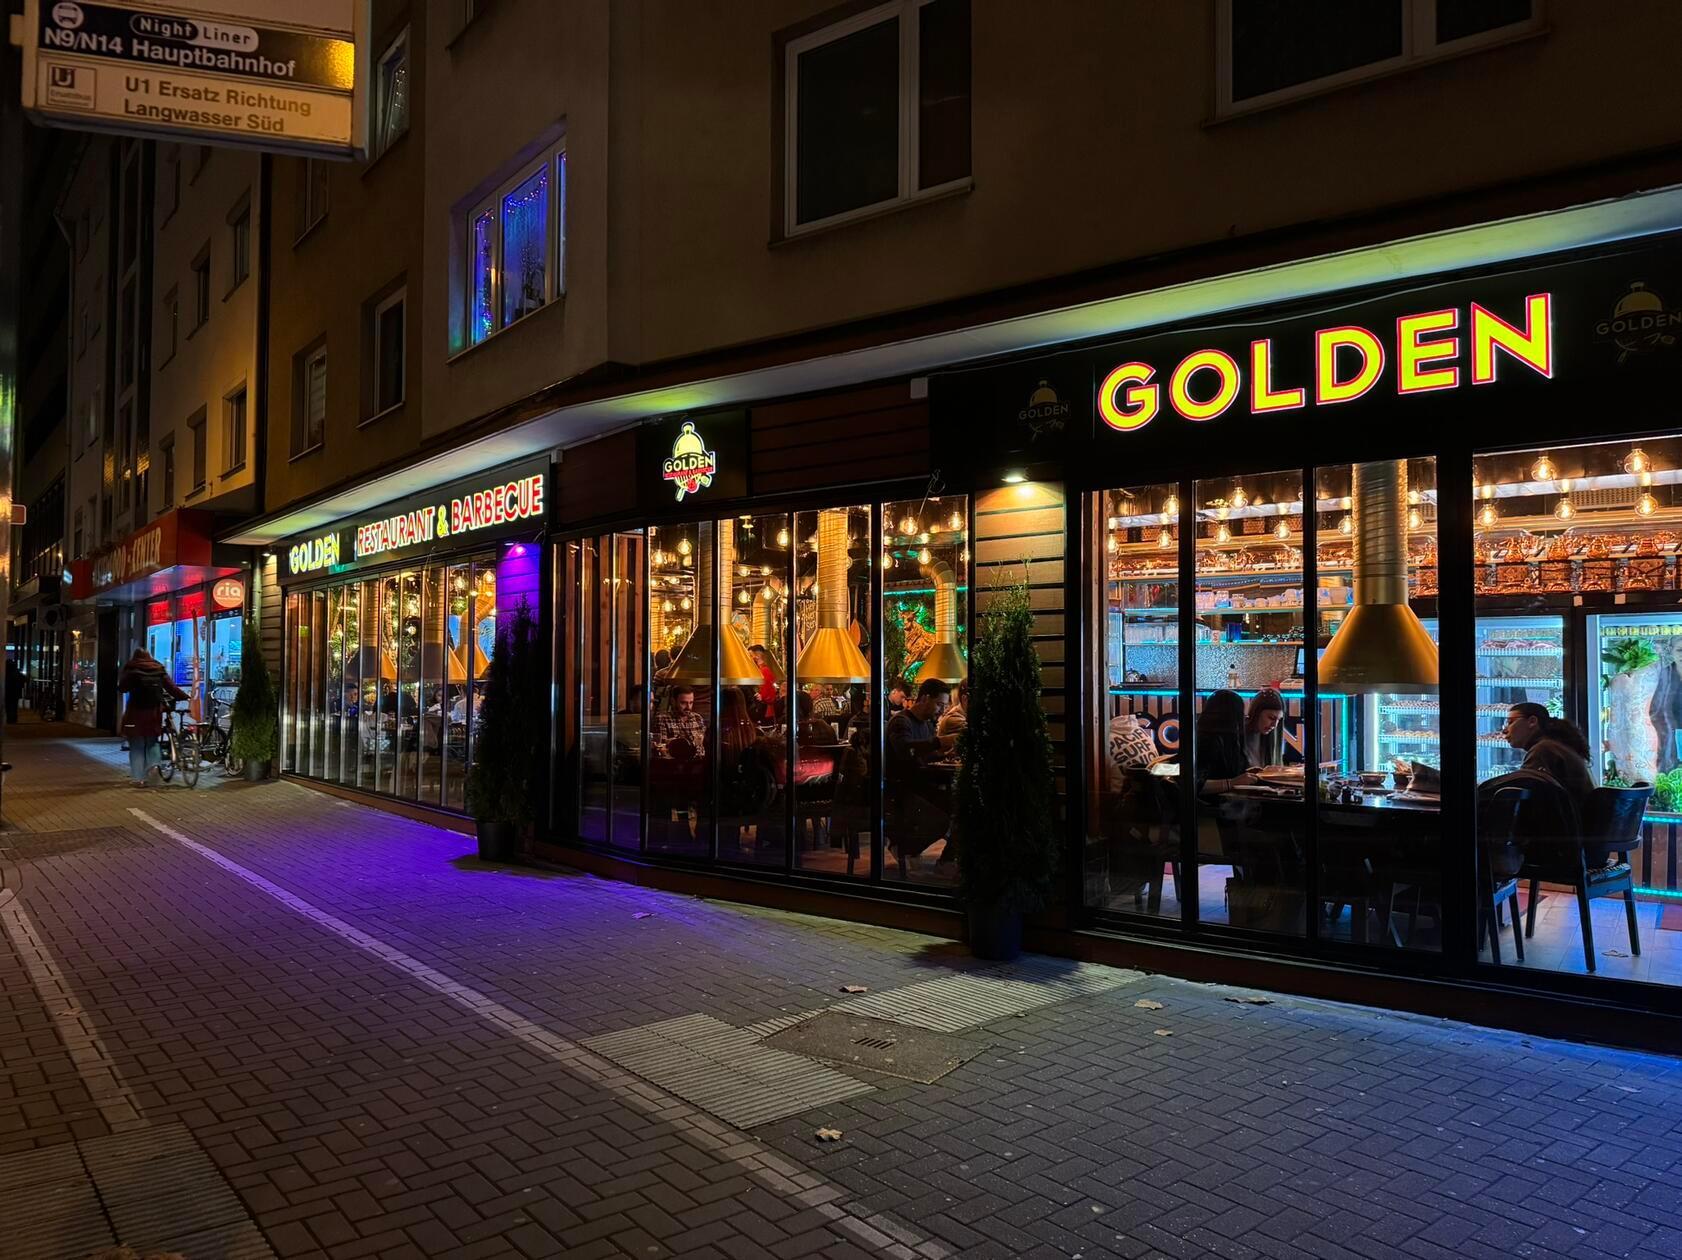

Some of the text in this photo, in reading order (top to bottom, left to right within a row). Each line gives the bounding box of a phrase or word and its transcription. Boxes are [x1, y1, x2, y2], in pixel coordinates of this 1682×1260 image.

[139, 17, 251, 44] Night Liner
[43, 26, 297, 76] N9/N14 Hauptbahnhof
[125, 74, 312, 117] U1 Ersatz Richtung
[124, 99, 285, 133] Langwasser Süd
[1595, 311, 1682, 335] GOLDEN
[1097, 292, 1553, 431] GOLDEN
[1018, 403, 1069, 420] GOLDEN
[664, 454, 714, 473] GOLDEN
[289, 474, 544, 575] GOLDEN RESTAURANT & BARBECUE
[216, 582, 241, 597] ria
[1114, 739, 1151, 764] SURF
